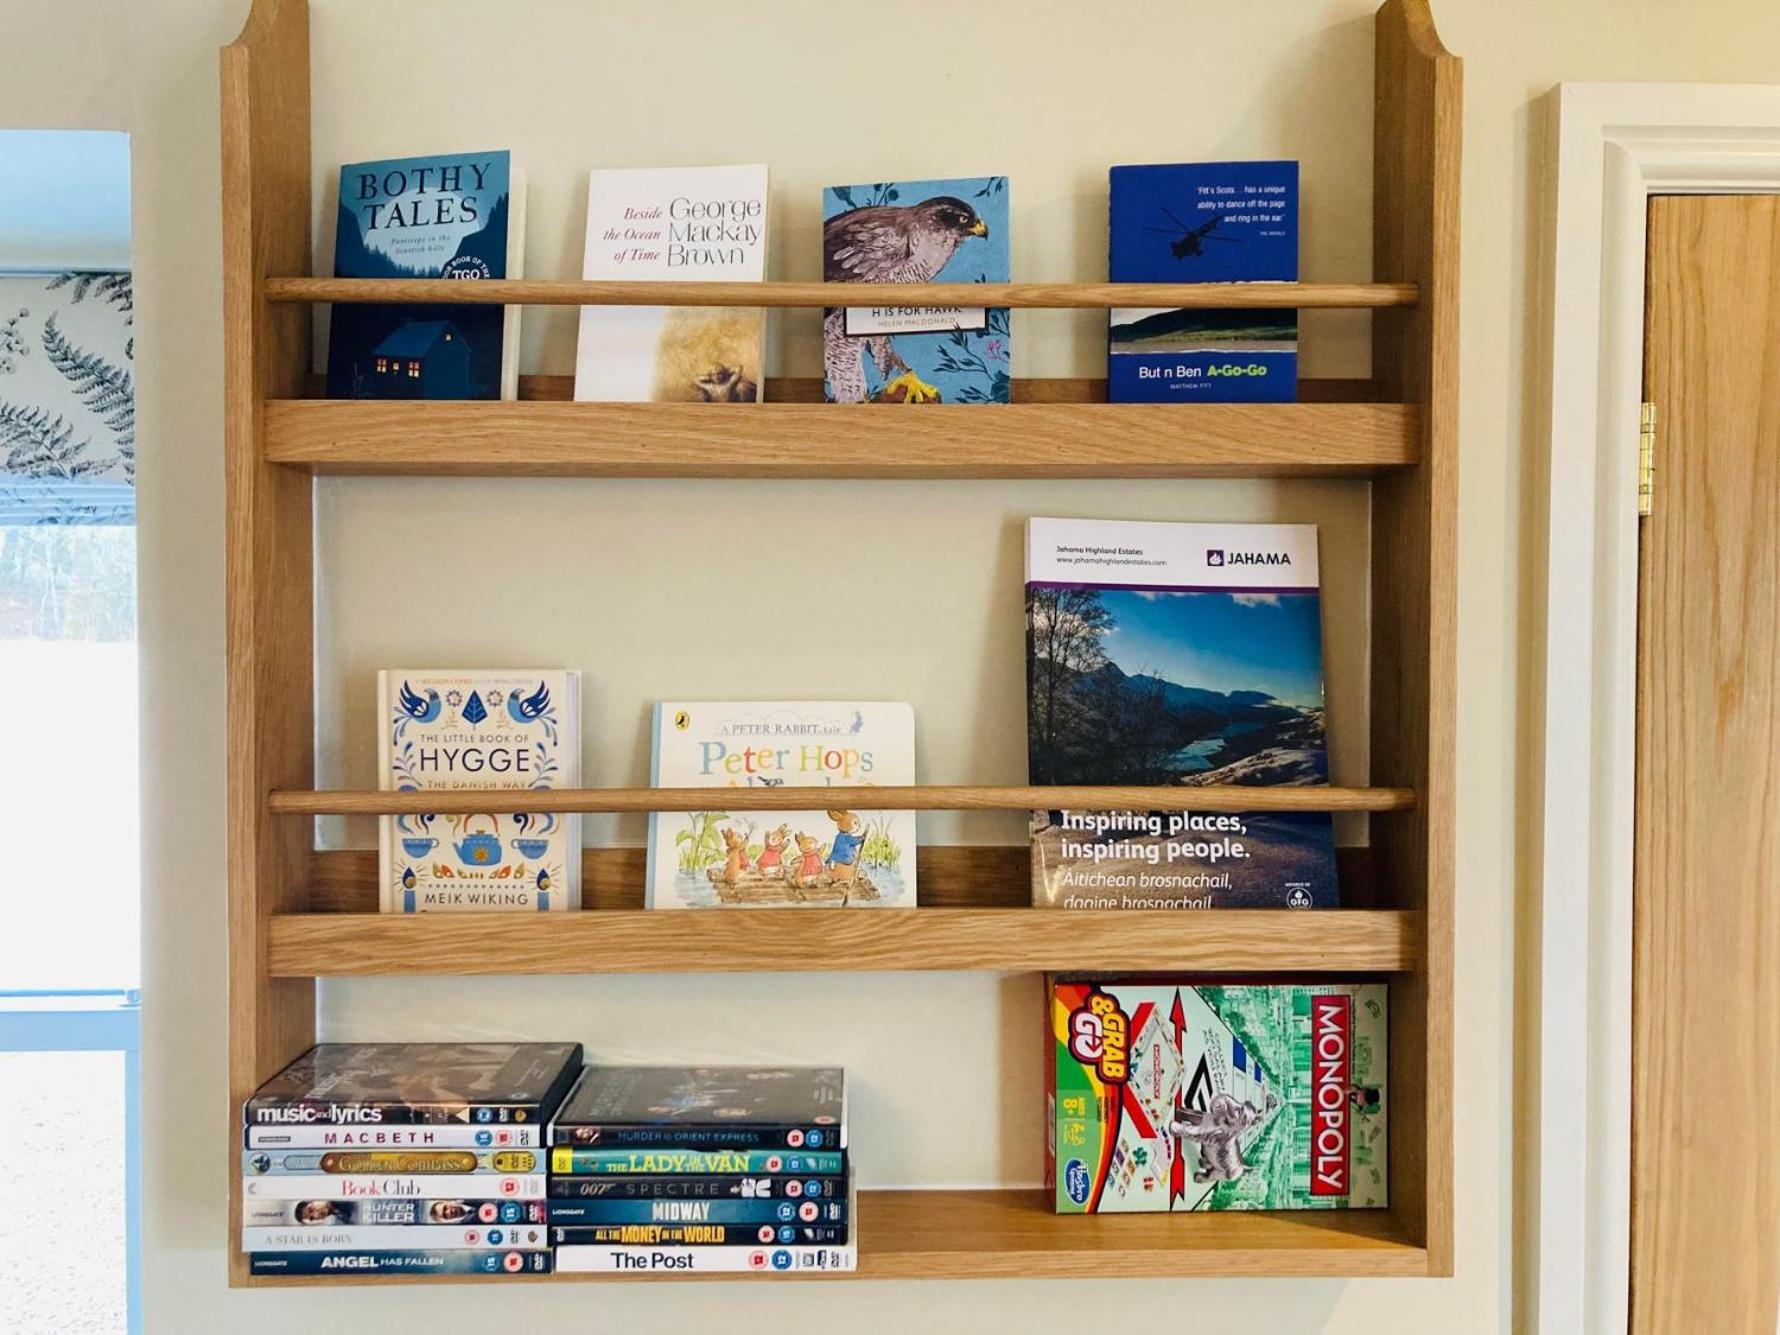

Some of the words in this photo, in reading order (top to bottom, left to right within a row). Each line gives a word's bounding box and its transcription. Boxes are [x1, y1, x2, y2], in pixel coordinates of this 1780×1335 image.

[356, 162, 492, 200] BOTHY
[363, 196, 478, 230] TALES
[624, 207, 663, 220] Beside
[669, 197, 761, 222] George
[603, 228, 619, 241] the
[624, 228, 661, 241] Ocean
[668, 222, 761, 246] Mackay
[614, 251, 627, 264] of
[631, 248, 661, 261] Time
[667, 244, 744, 267] Brown
[452, 269, 481, 280] TGO
[872, 307, 880, 317] H
[884, 307, 894, 316] IS
[898, 306, 921, 316] FOR
[1138, 366, 1161, 379] But
[1164, 368, 1173, 378] n
[1176, 365, 1202, 378] Ben
[1206, 364, 1268, 377] A-Go-Go
[1085, 547, 1117, 555] Highland
[1228, 552, 1291, 566] JAHAMA
[721, 726, 729, 734] A
[732, 724, 771, 735] PETER
[824, 726, 842, 734] tale
[421, 734, 441, 743] THE
[444, 734, 475, 743] LITTLE
[479, 734, 510, 742] BOOK
[514, 734, 529, 742] OF
[420, 748, 529, 772] HYGGE
[698, 741, 790, 775] Peter
[799, 744, 874, 779] Hops
[427, 780, 446, 789] THE
[451, 780, 497, 789] DANISH
[502, 779, 527, 789] WAY
[1061, 809, 1162, 836] Inspiring
[1169, 810, 1247, 836] places,
[1061, 838, 1160, 865] inspiring
[1167, 837, 1251, 863] people.
[1139, 873, 1233, 890] brosnachail,
[424, 893, 463, 905] MEIK
[467, 893, 529, 905] WIKING
[1091, 996, 1114, 1016] &
[1075, 1013, 1103, 1059] GO
[1102, 1013, 1126, 1079] GRAB
[1318, 1005, 1344, 1189] MONOPOLY
[258, 1104, 316, 1122] music
[331, 1104, 382, 1124] lyrics
[324, 1132, 435, 1144] MACBETH
[618, 1131, 663, 1141] MURDER
[674, 1132, 711, 1141] ORIENT
[713, 1132, 760, 1142] EXPRESS
[606, 1163, 628, 1172] THE
[629, 1154, 687, 1172] LADY
[704, 1154, 750, 1172] VAN
[342, 1180, 380, 1195] Book
[383, 1179, 420, 1195] Club
[581, 1182, 613, 1195] 007
[626, 1183, 719, 1195] SPECTRE
[1075, 1161, 1089, 1201] Hasbro
[363, 1203, 415, 1212] HUNTER
[652, 1202, 710, 1220] MIDWAY
[363, 1212, 415, 1222] KILLER
[276, 1235, 303, 1244] STAR
[307, 1235, 319, 1243] IS
[322, 1235, 353, 1243] BORN
[595, 1230, 607, 1240] ALL
[609, 1230, 621, 1240] THE
[621, 1226, 662, 1243] MONEY
[671, 1230, 683, 1240] THE
[684, 1226, 725, 1243] WORLD
[321, 1256, 379, 1268] ANGEL
[381, 1258, 403, 1266] HAS
[405, 1257, 444, 1266] FALLEN
[610, 1252, 648, 1268] The
[652, 1252, 694, 1268] Post
